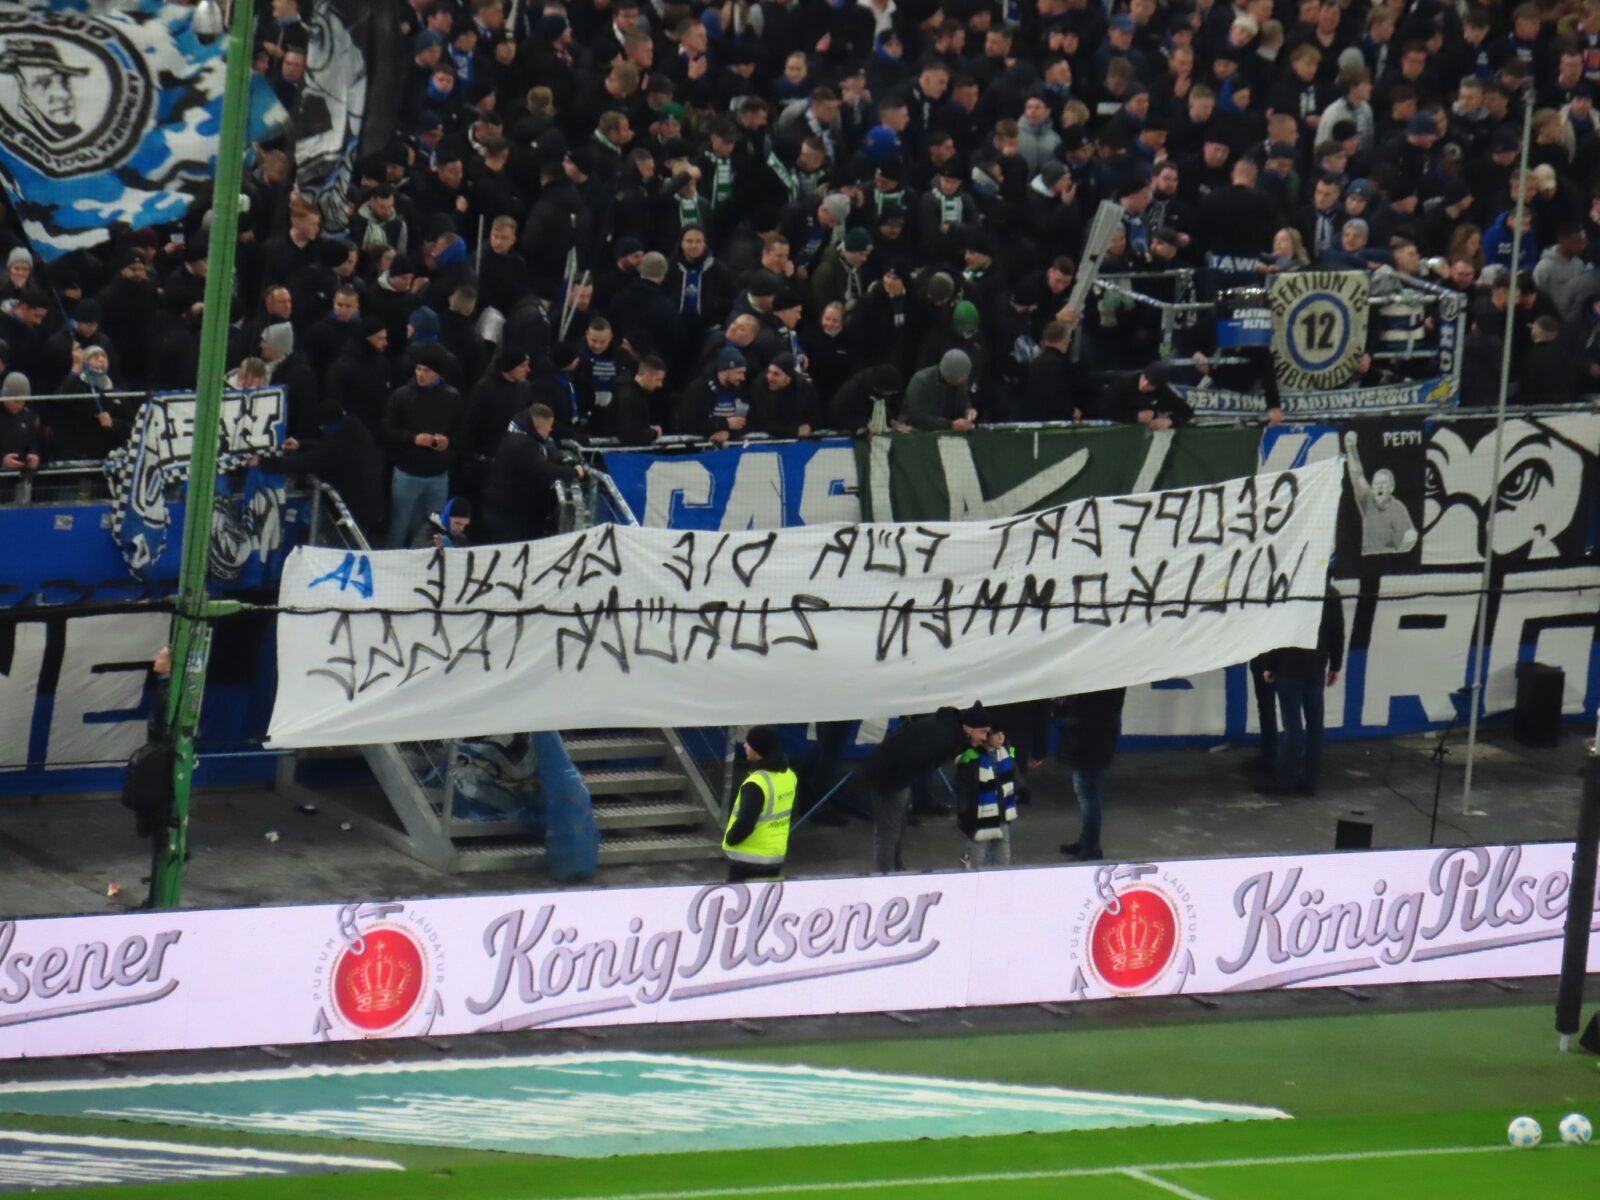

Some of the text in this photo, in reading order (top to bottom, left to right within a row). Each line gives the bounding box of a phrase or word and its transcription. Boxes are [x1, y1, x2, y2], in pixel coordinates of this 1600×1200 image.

[1271, 273, 1347, 317] SEKTION
[1301, 311, 1336, 351] 12
[1382, 430, 1422, 448] PEPPI
[465, 881, 943, 1016] König Pilsener
[1070, 871, 1198, 961] PURUM LAUDATUR
[1216, 844, 1571, 975] König Pilse
[312, 910, 446, 1001] PURUM LAUDATUR
